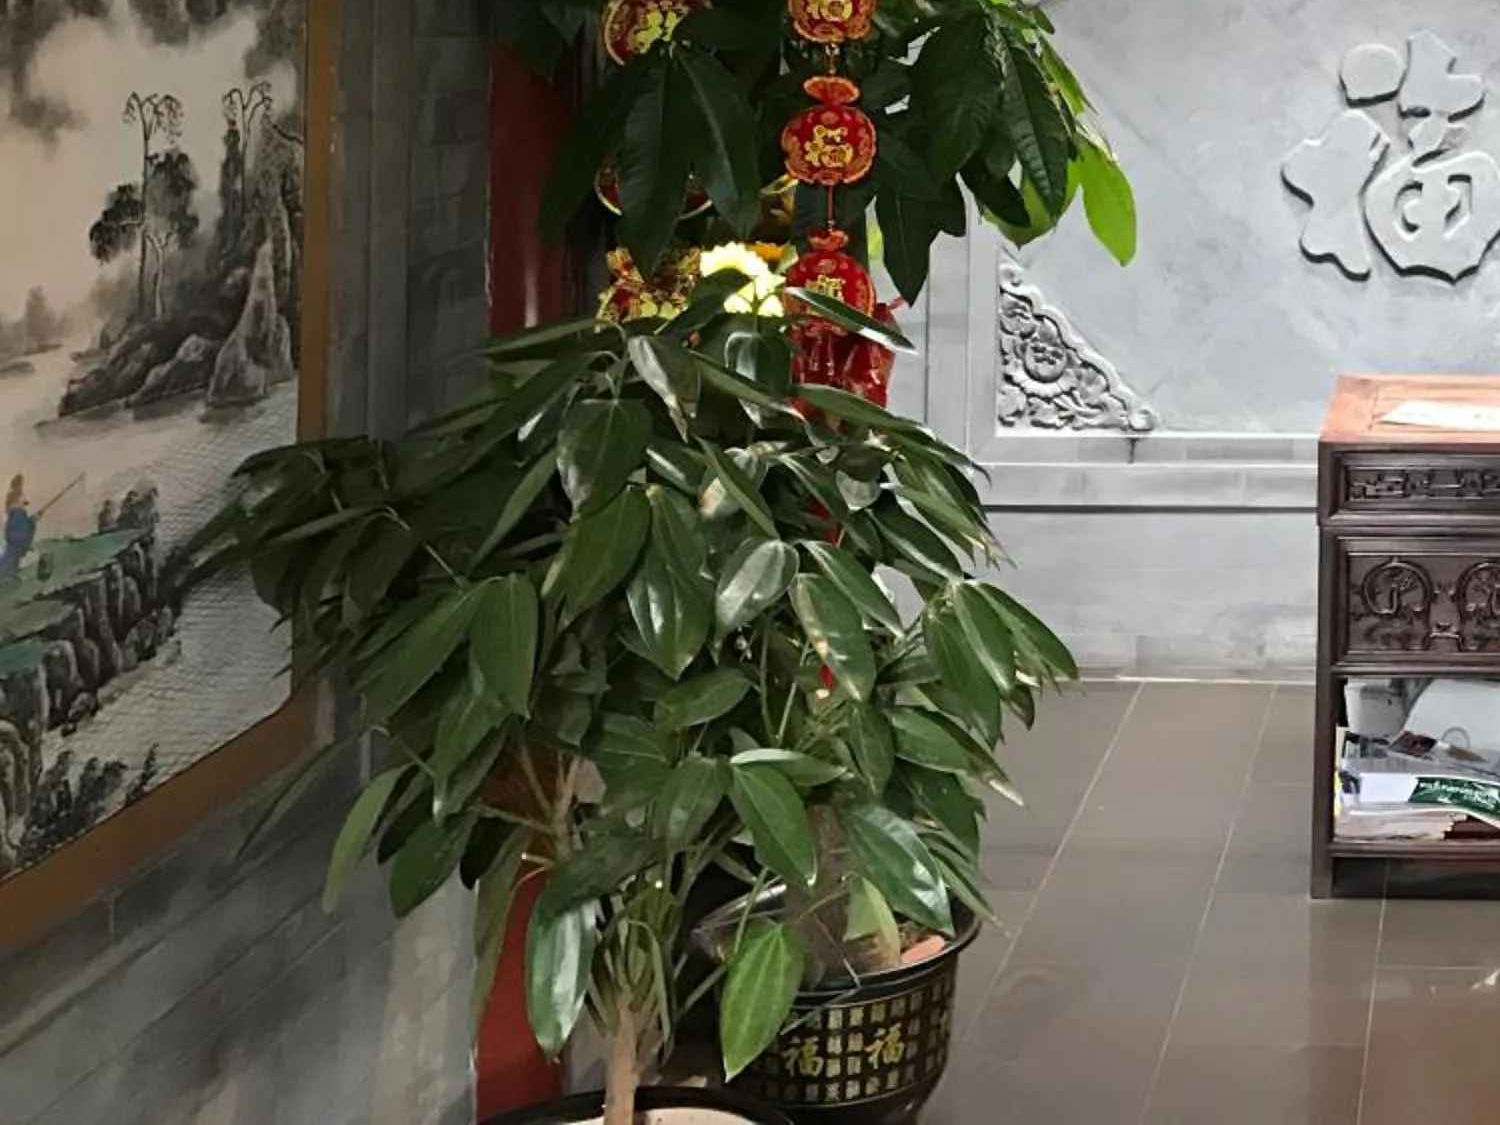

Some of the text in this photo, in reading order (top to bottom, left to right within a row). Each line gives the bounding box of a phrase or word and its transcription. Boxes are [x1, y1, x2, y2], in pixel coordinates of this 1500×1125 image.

[804, 125, 853, 167] 福
[781, 1035, 825, 1077] 福
[863, 1022, 905, 1070] 福
